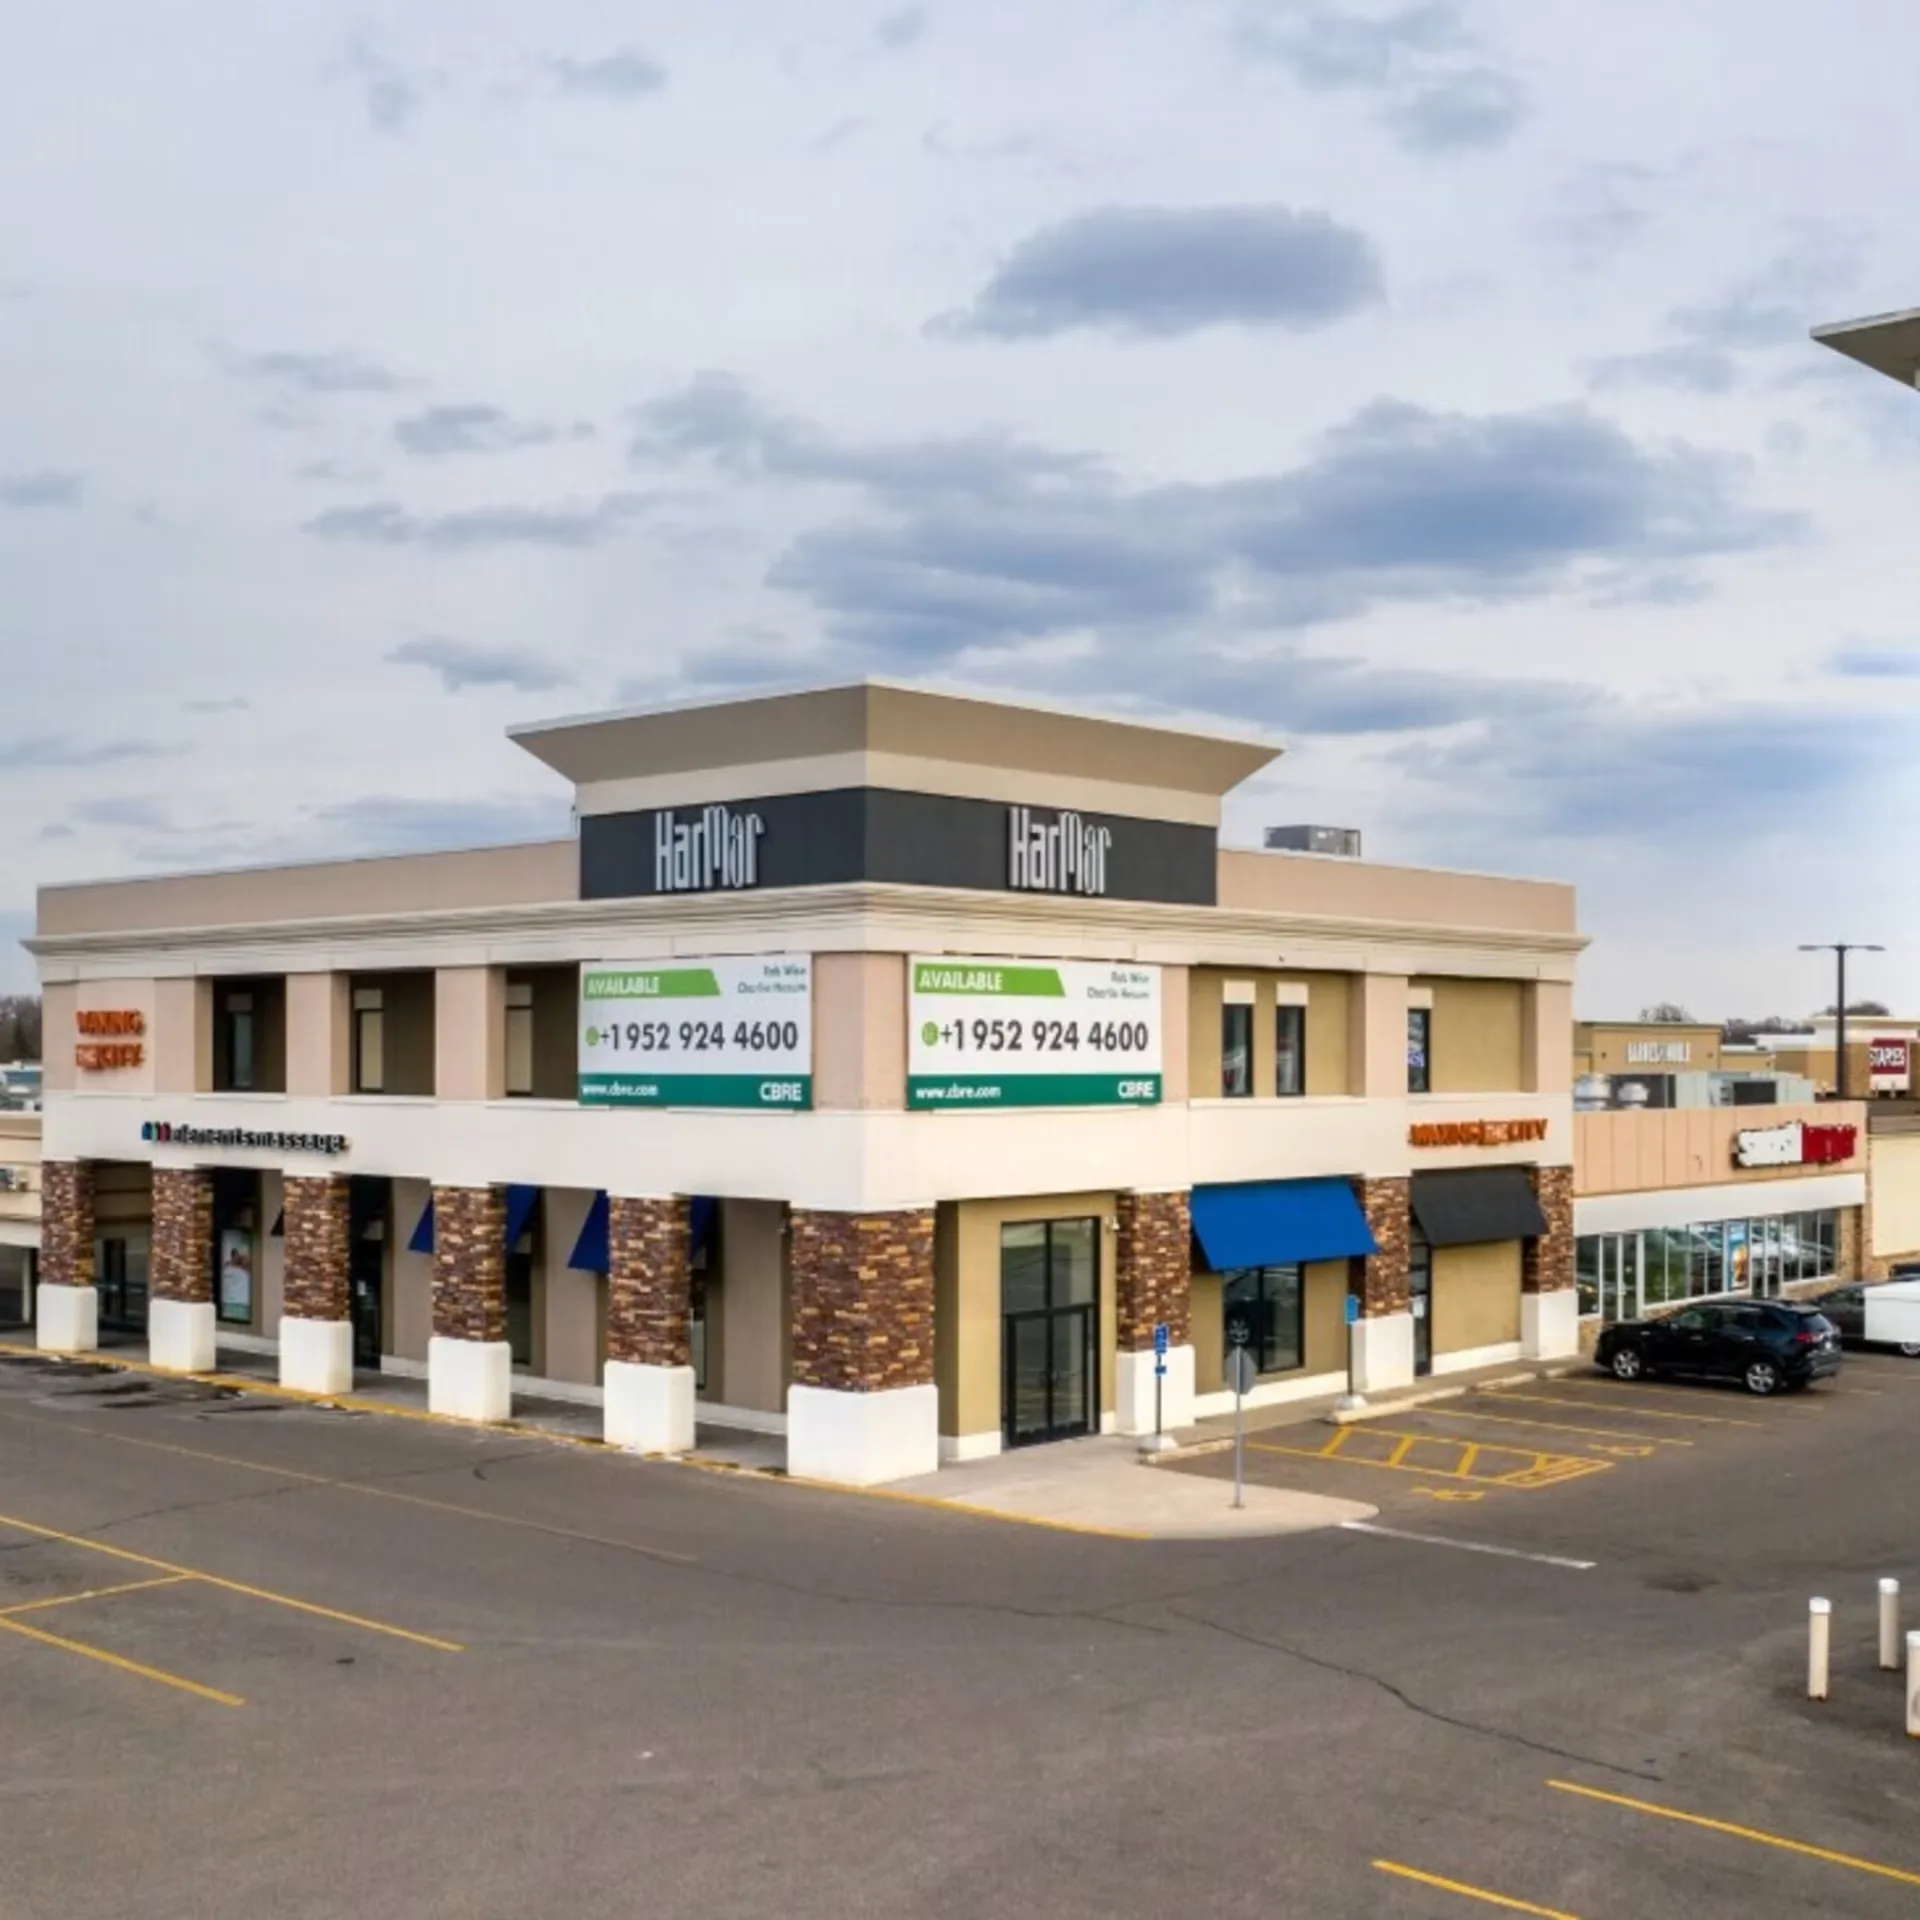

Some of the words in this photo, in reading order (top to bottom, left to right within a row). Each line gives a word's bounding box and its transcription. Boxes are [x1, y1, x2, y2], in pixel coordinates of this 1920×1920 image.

[587, 976, 660, 995] AVAILABLE
[918, 970, 1003, 990] AVAILABLE
[626, 1022, 670, 1050] 952
[679, 1022, 725, 1050] 924
[733, 1021, 798, 1050] 4600
[972, 1020, 1022, 1050] 952
[1032, 1021, 1079, 1051] 924
[1088, 1022, 1148, 1051] 4600
[759, 1082, 802, 1101] CBRE
[916, 1083, 1001, 1099] www.cbre.com
[1118, 1080, 1155, 1098] CBRE
